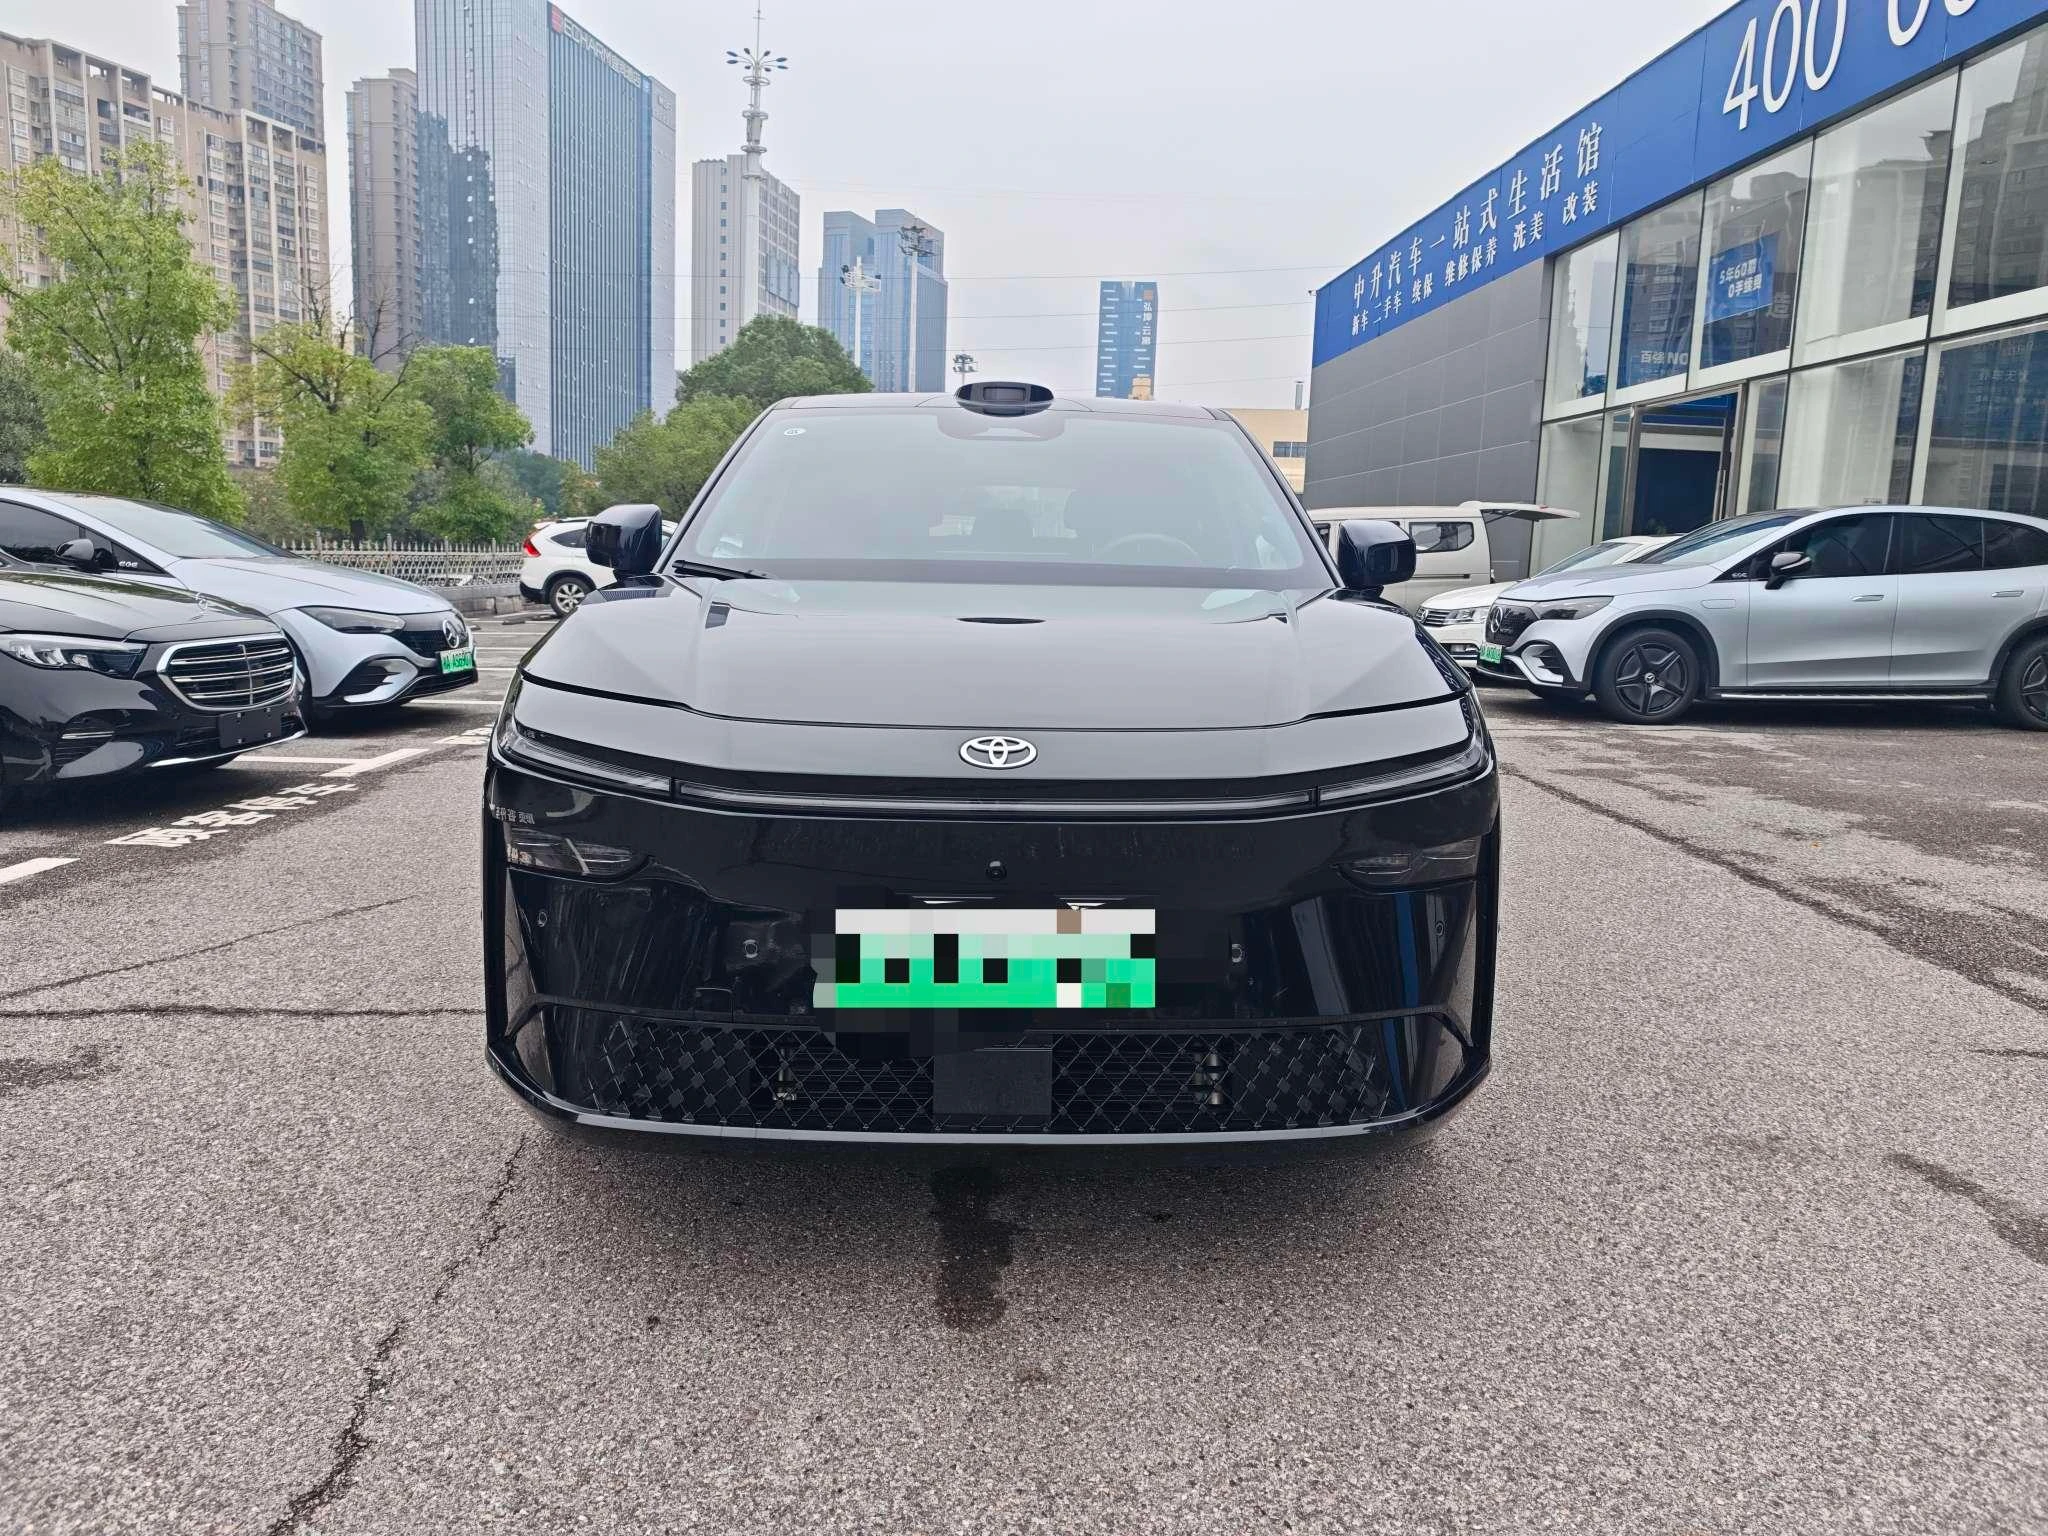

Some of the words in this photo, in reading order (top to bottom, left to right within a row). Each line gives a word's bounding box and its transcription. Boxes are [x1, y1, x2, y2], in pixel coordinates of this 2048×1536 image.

[1722, 0, 1847, 131] 400
[1351, 309, 1369, 336] 新车
[1373, 290, 1402, 324] 二手车
[1444, 236, 1498, 287] 维修保养
[1513, 210, 1545, 252] 洗美
[1562, 180, 1598, 225] 改装
[1353, 122, 1603, 309] 中升汽车一站式生活馆
